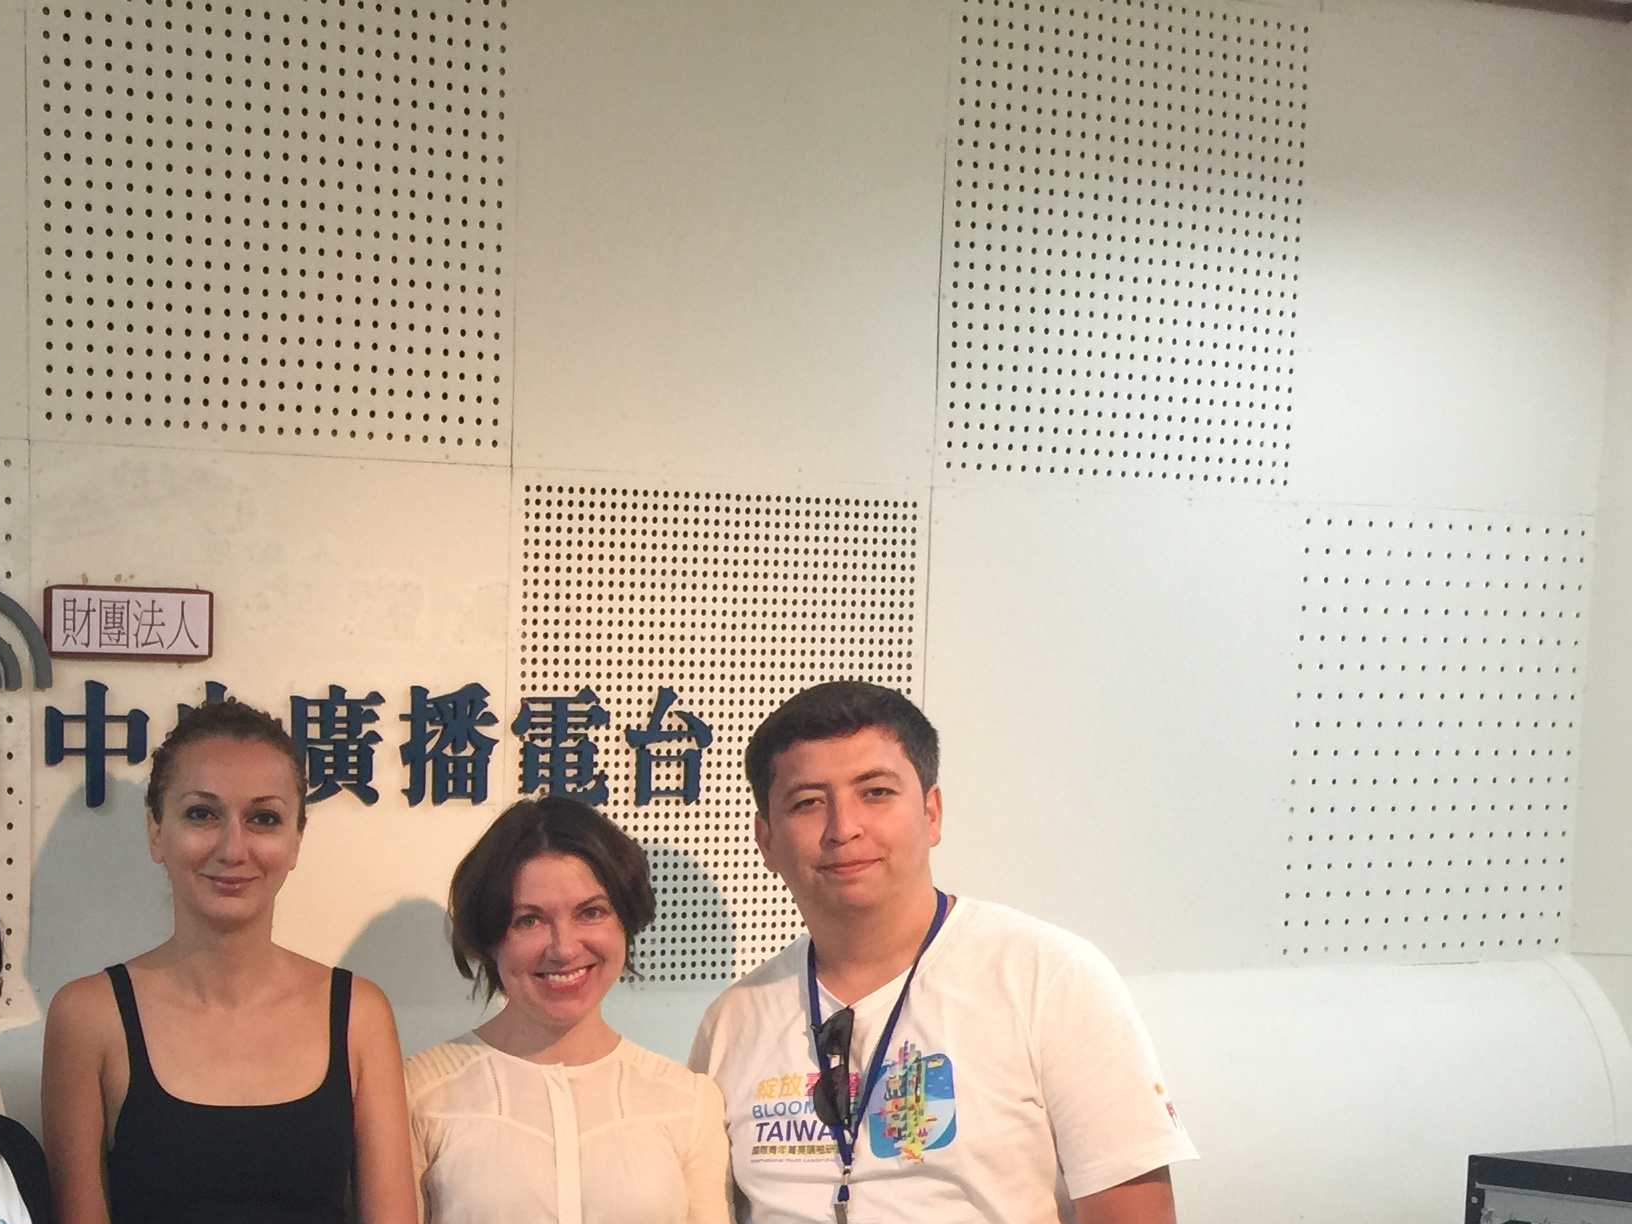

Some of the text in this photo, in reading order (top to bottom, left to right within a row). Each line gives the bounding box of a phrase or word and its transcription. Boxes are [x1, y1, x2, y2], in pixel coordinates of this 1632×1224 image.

[61, 597, 200, 650] 財團法人
[44, 680, 713, 808] 中廣播電台
[756, 1119, 856, 1142] TAIWA
